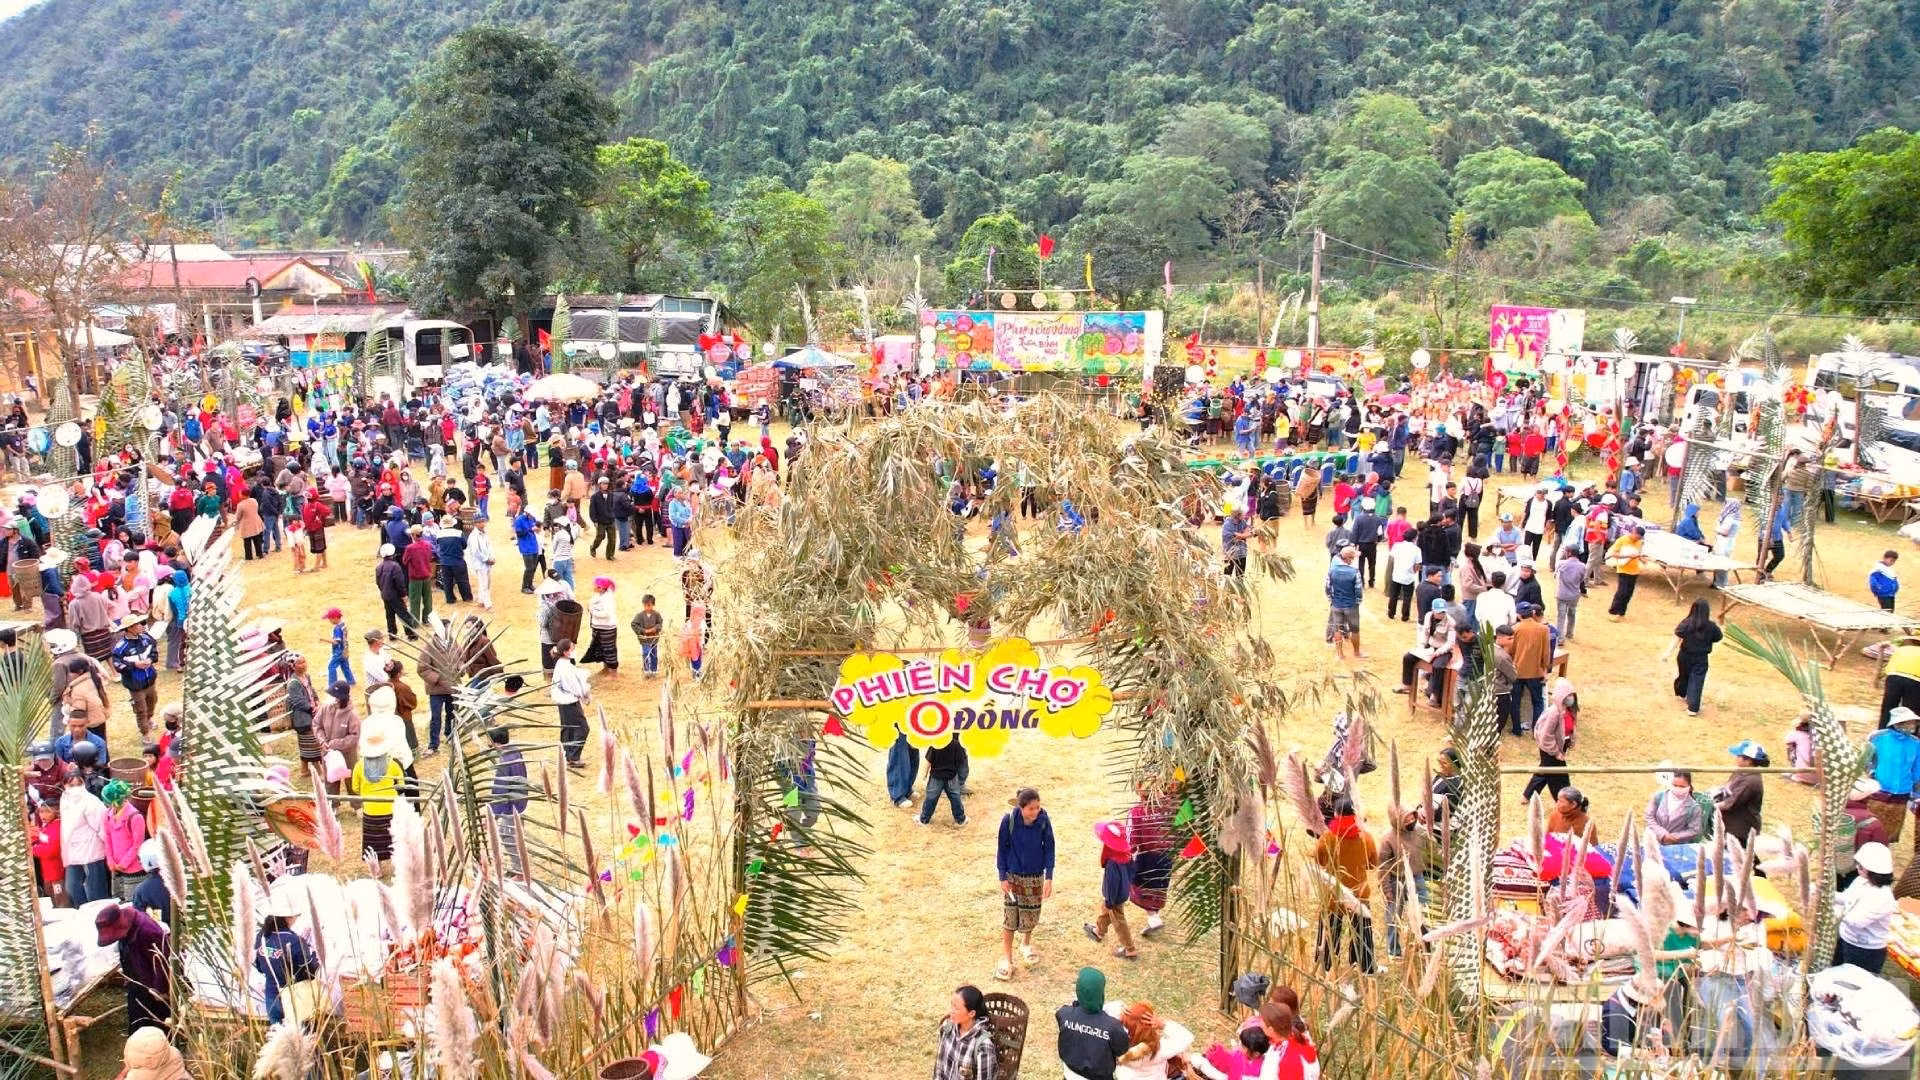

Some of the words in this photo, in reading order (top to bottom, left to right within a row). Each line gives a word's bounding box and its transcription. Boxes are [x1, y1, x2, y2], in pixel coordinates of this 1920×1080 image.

[833, 660, 971, 711] PHIÊN
[991, 665, 1085, 709] CHỢ
[953, 699, 1040, 730] ĐỒNG
